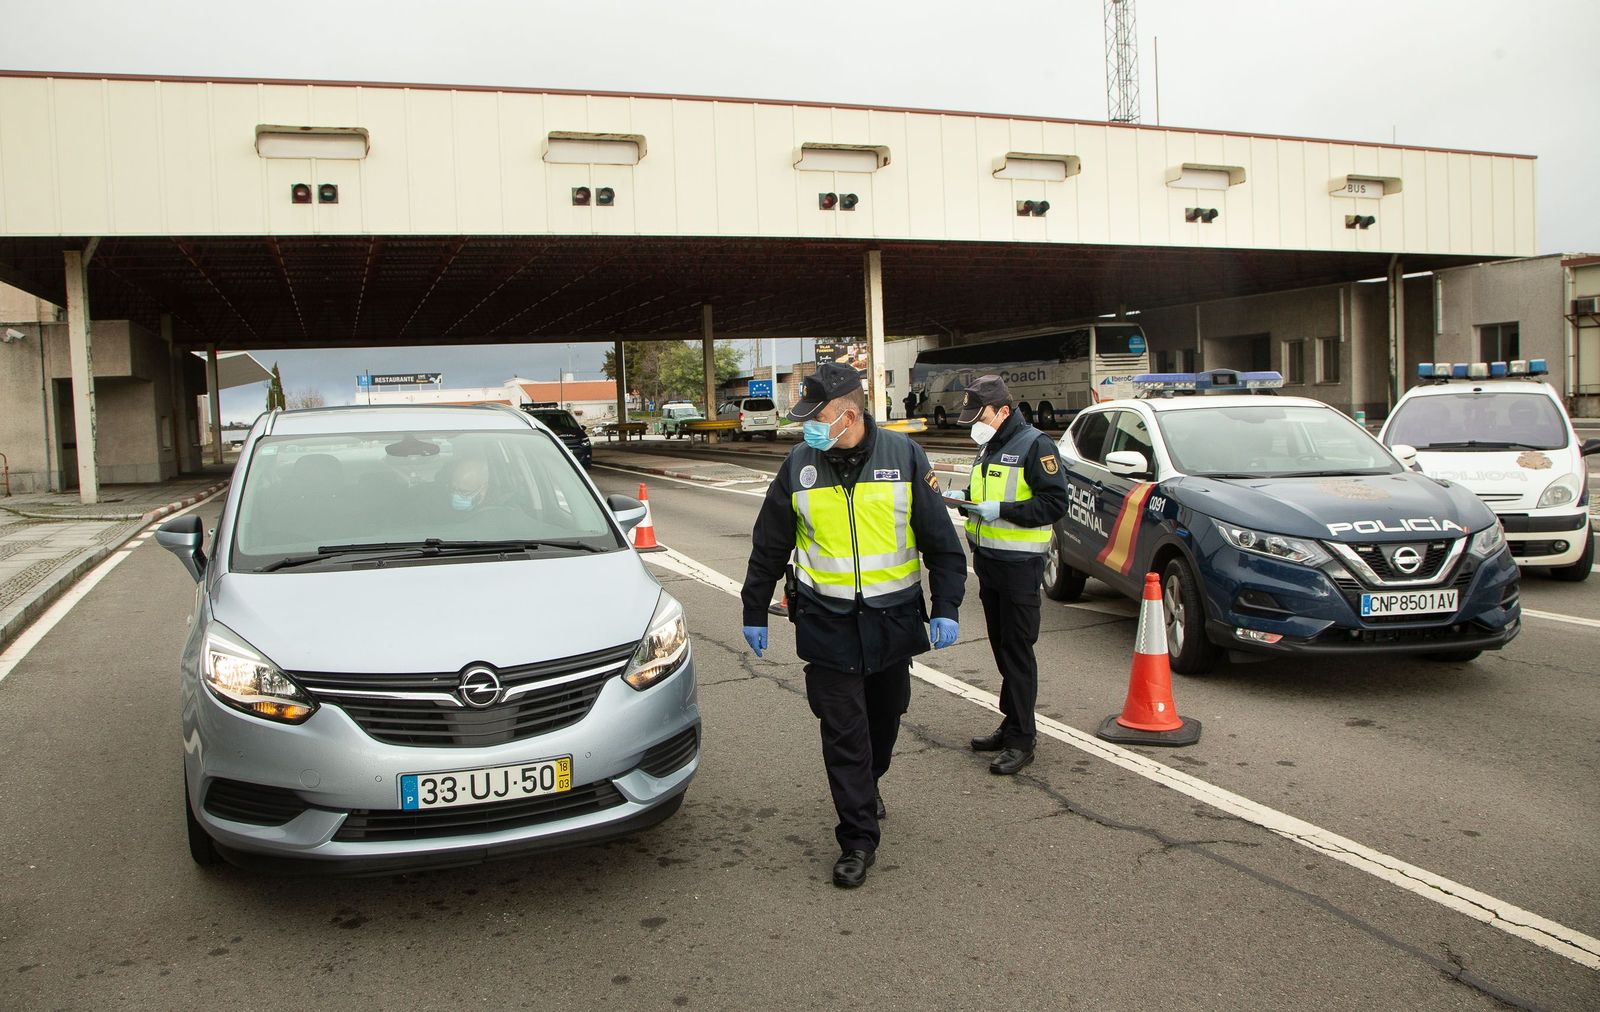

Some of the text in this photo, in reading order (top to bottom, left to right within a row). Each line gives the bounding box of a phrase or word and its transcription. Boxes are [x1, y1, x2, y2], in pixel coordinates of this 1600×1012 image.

[1347, 184, 1366, 193] BUS
[1068, 501, 1109, 539] ACIONAL
[1370, 592, 1455, 612] CNP8501AV
[559, 762, 568, 772] 18
[558, 778, 570, 789] 03
[406, 796, 414, 804] P
